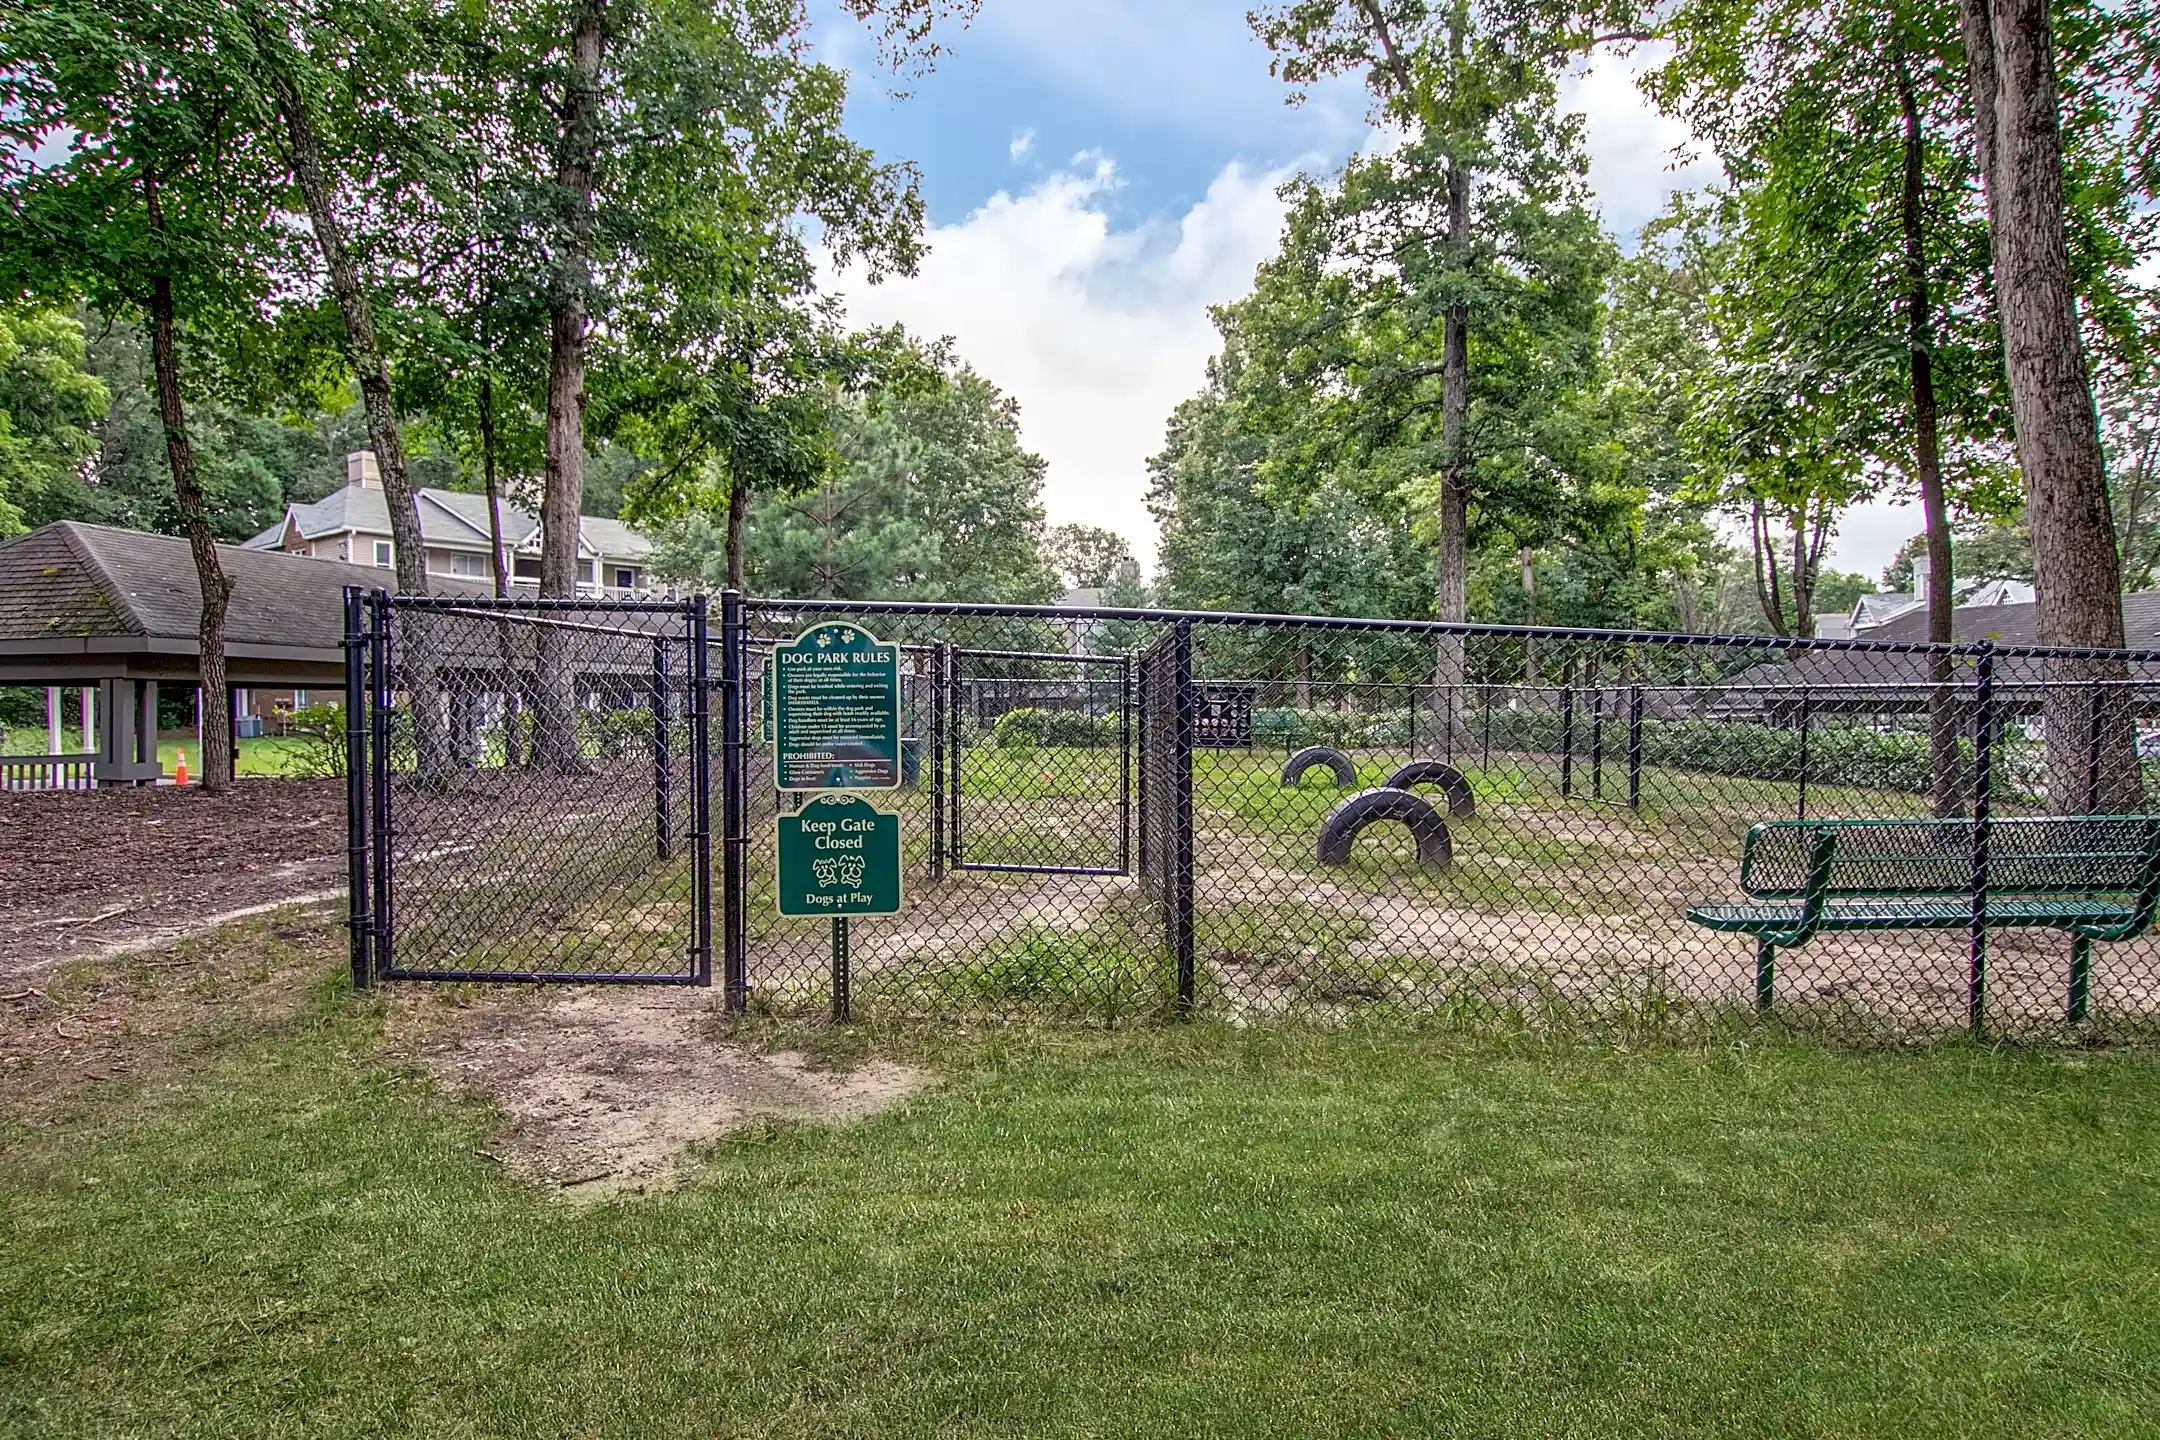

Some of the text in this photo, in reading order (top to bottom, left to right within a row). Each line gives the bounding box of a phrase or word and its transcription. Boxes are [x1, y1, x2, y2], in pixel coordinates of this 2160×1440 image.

[782, 652, 890, 664] DOG PARK RULES
[783, 752, 835, 760] PROHIBITED:
[801, 818, 876, 836] Keep Gate
[814, 835, 863, 850] Closed
[806, 892, 873, 907] Dogs at Play
